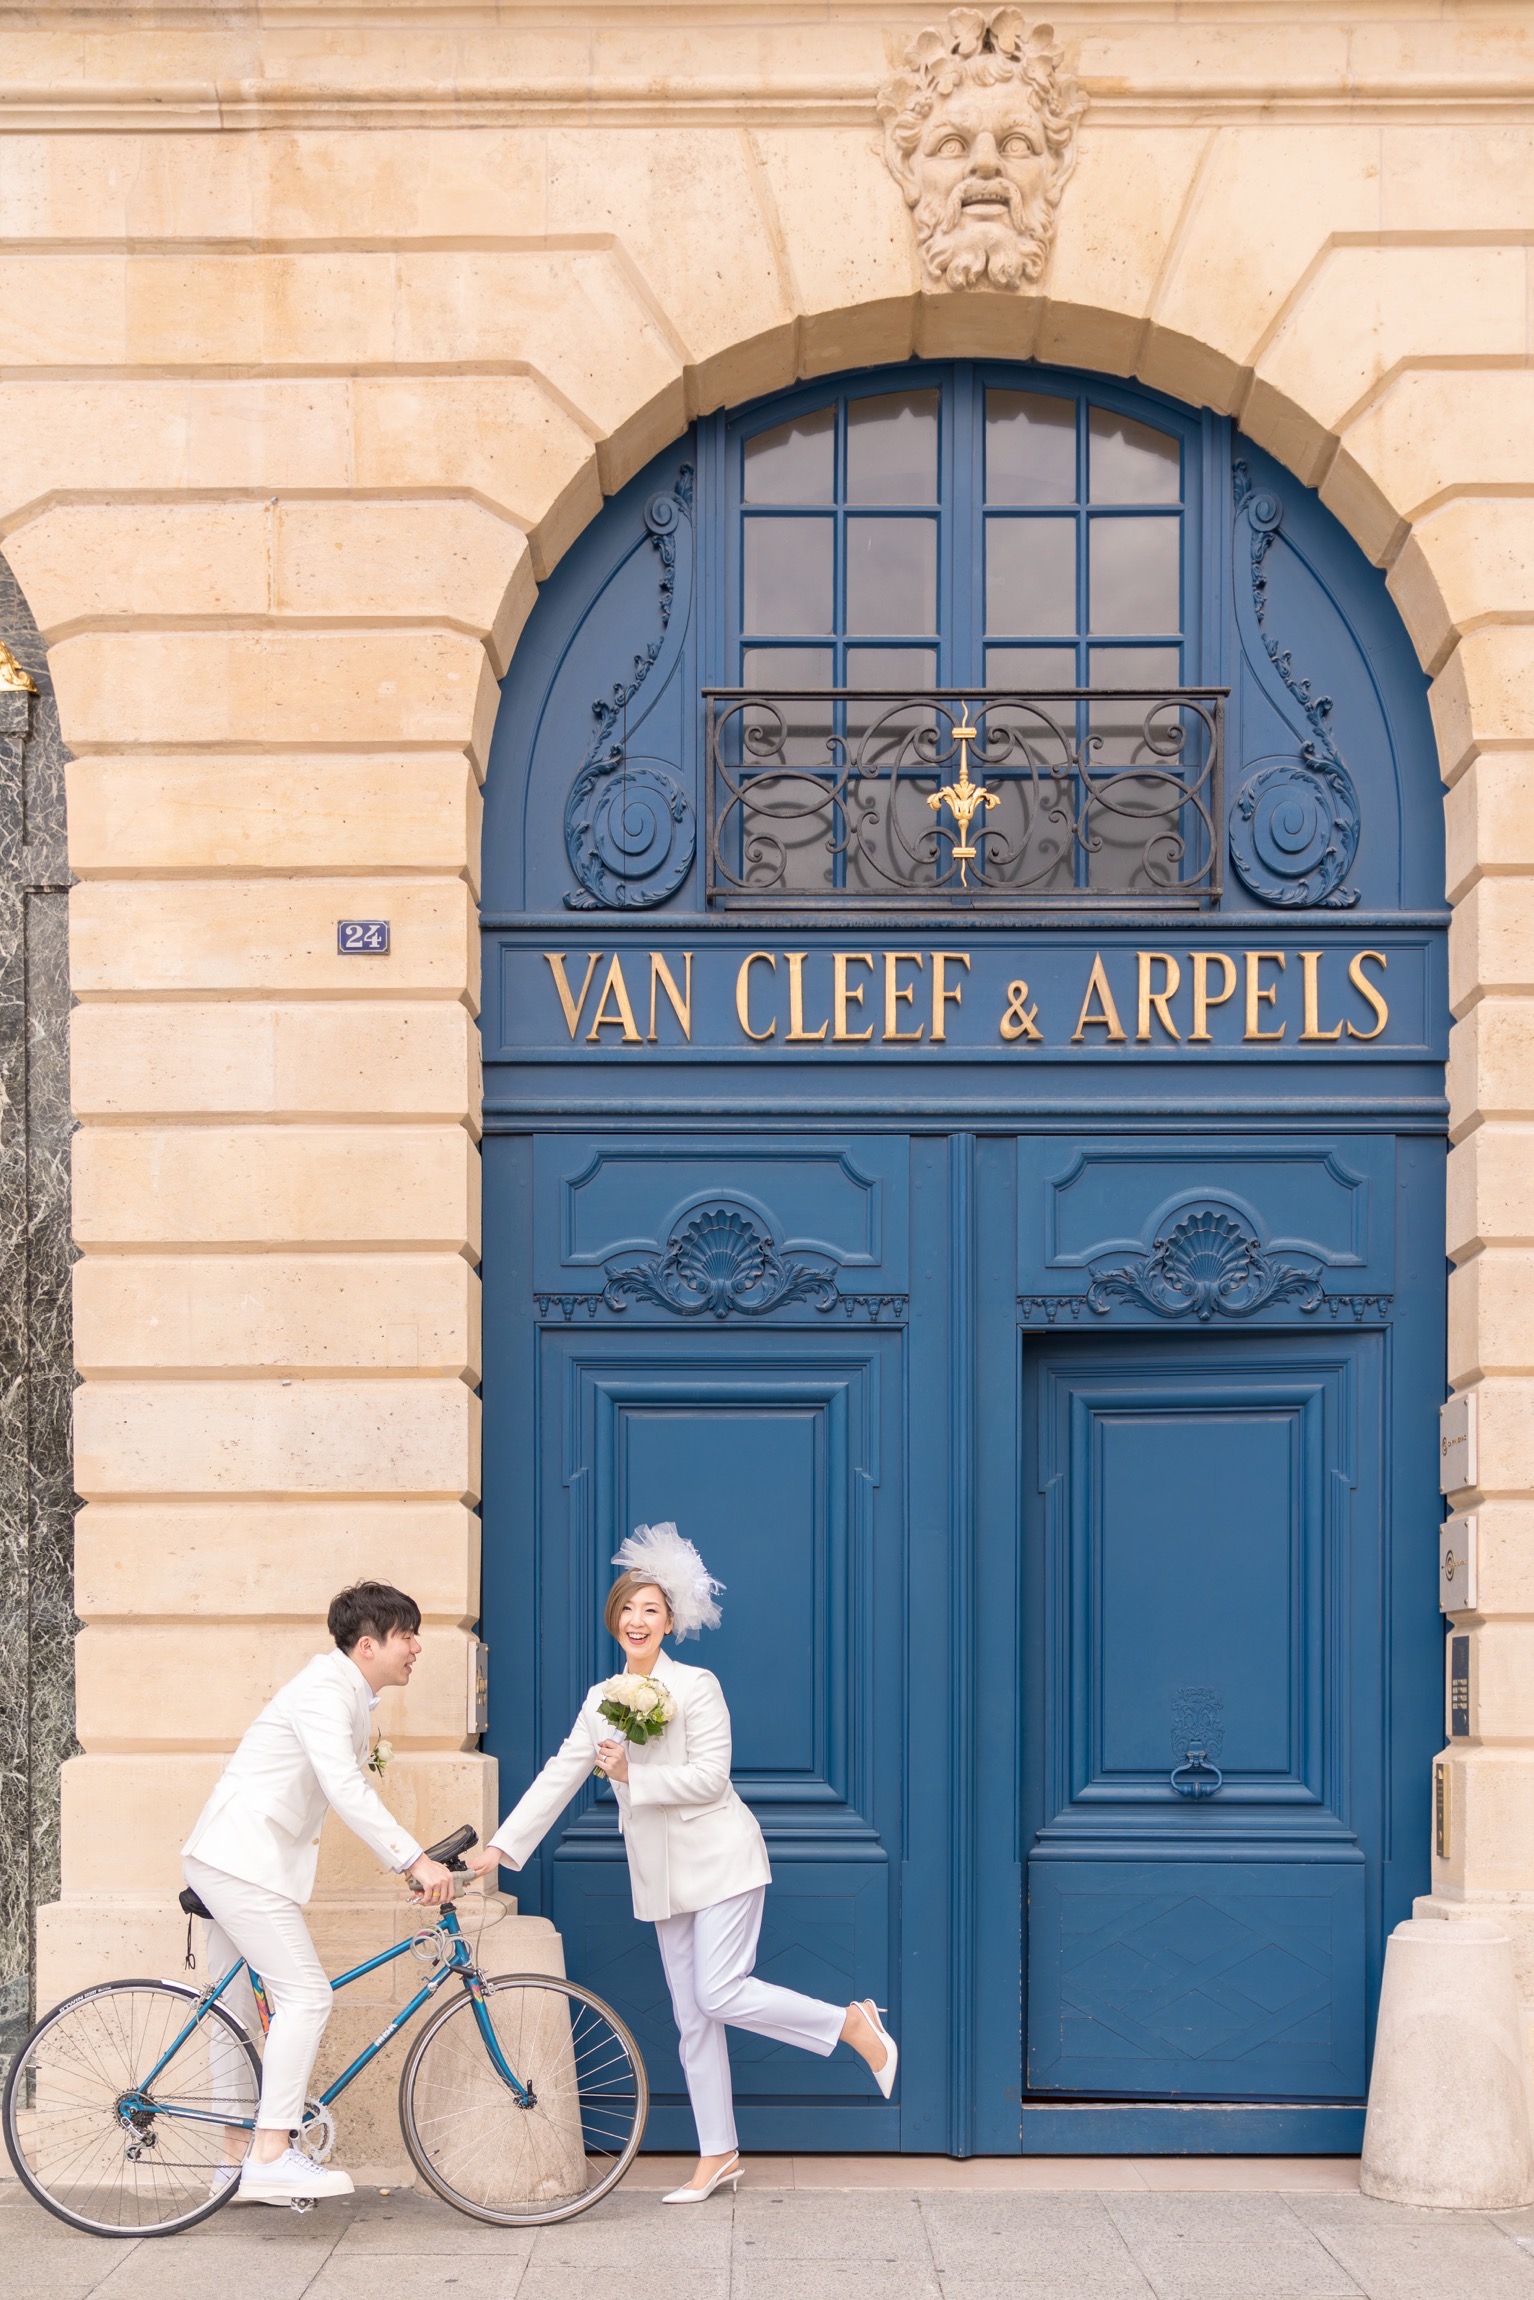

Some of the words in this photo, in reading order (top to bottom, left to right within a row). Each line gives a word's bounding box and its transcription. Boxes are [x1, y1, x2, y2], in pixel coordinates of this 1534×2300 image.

[345, 925, 382, 947] 24
[543, 952, 693, 1042] VAN
[735, 951, 971, 1041] CLEEF
[1000, 979, 1044, 1041] &
[1071, 950, 1389, 1041] ARPELS
